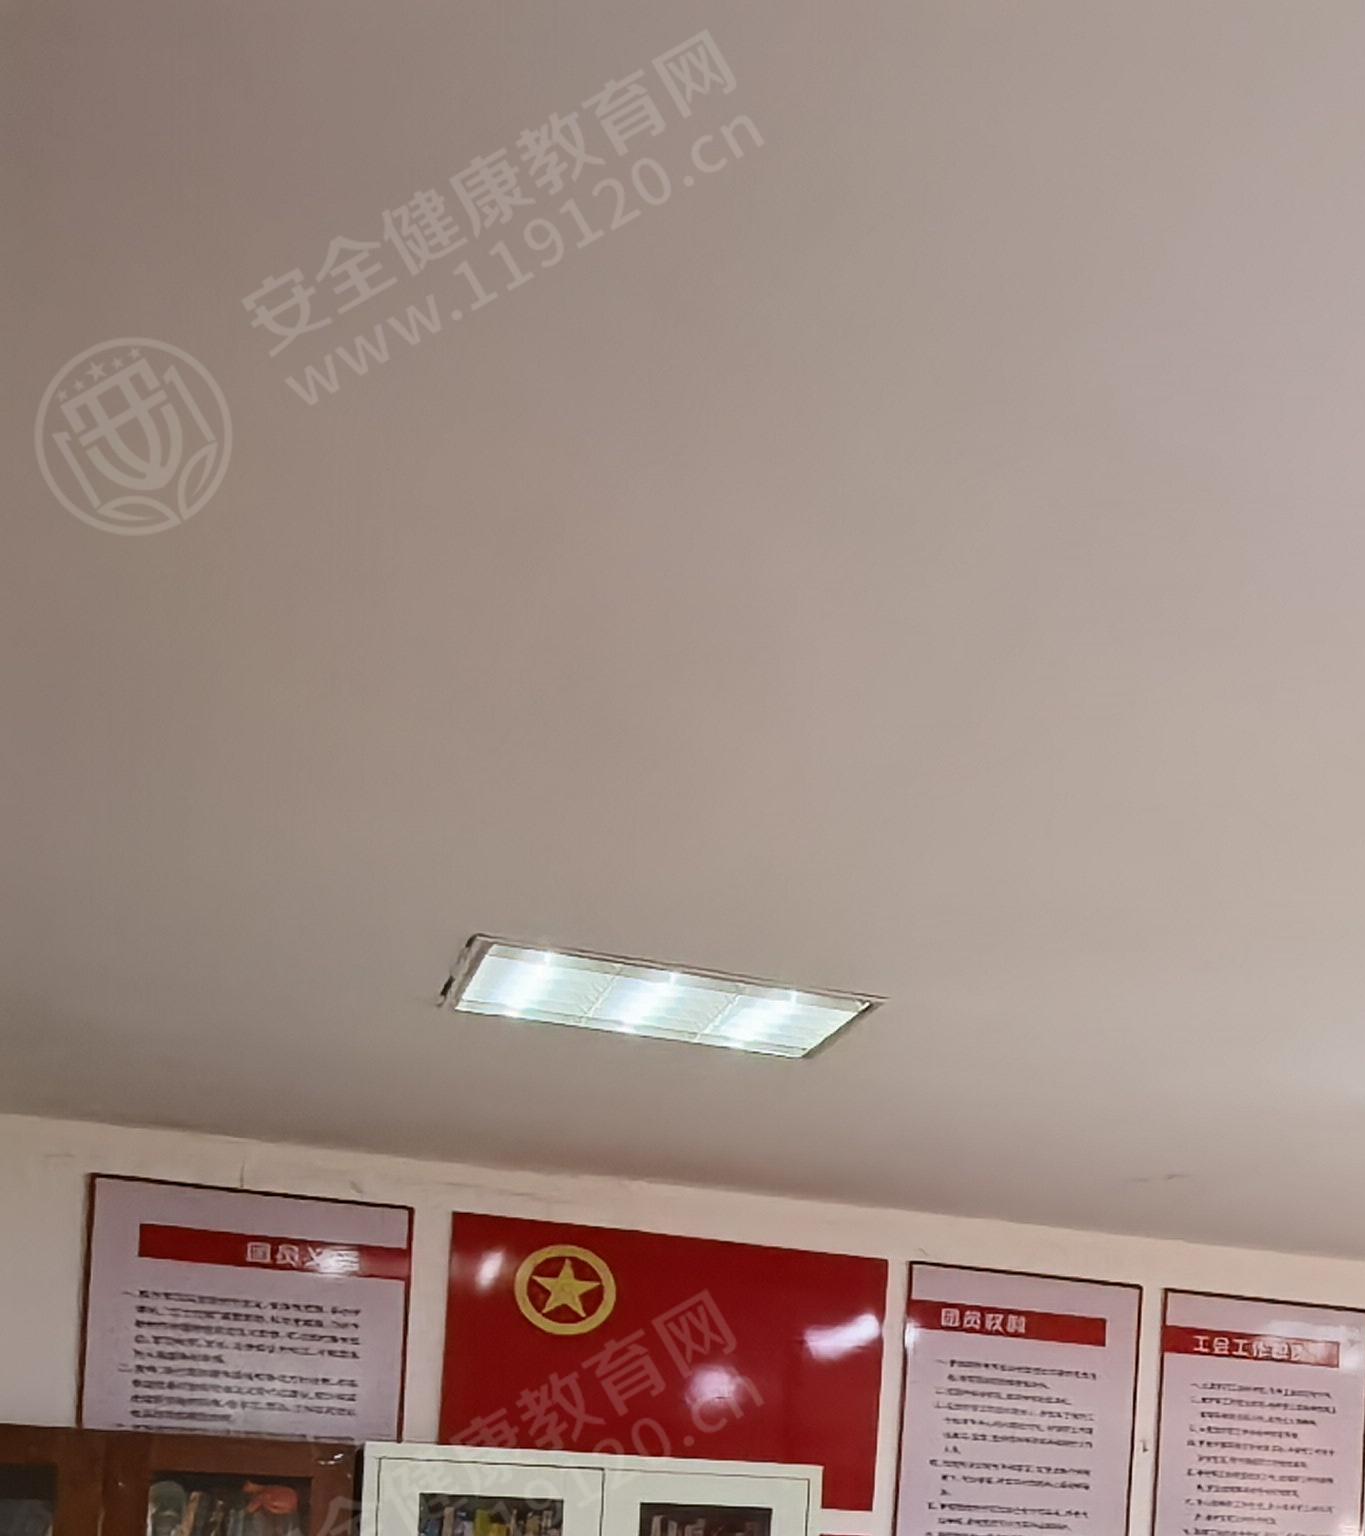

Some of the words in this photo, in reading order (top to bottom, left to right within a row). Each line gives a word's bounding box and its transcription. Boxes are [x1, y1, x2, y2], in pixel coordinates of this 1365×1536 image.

[246, 1241, 359, 1273] 团员义
[941, 1308, 1026, 1334] 团员权利
